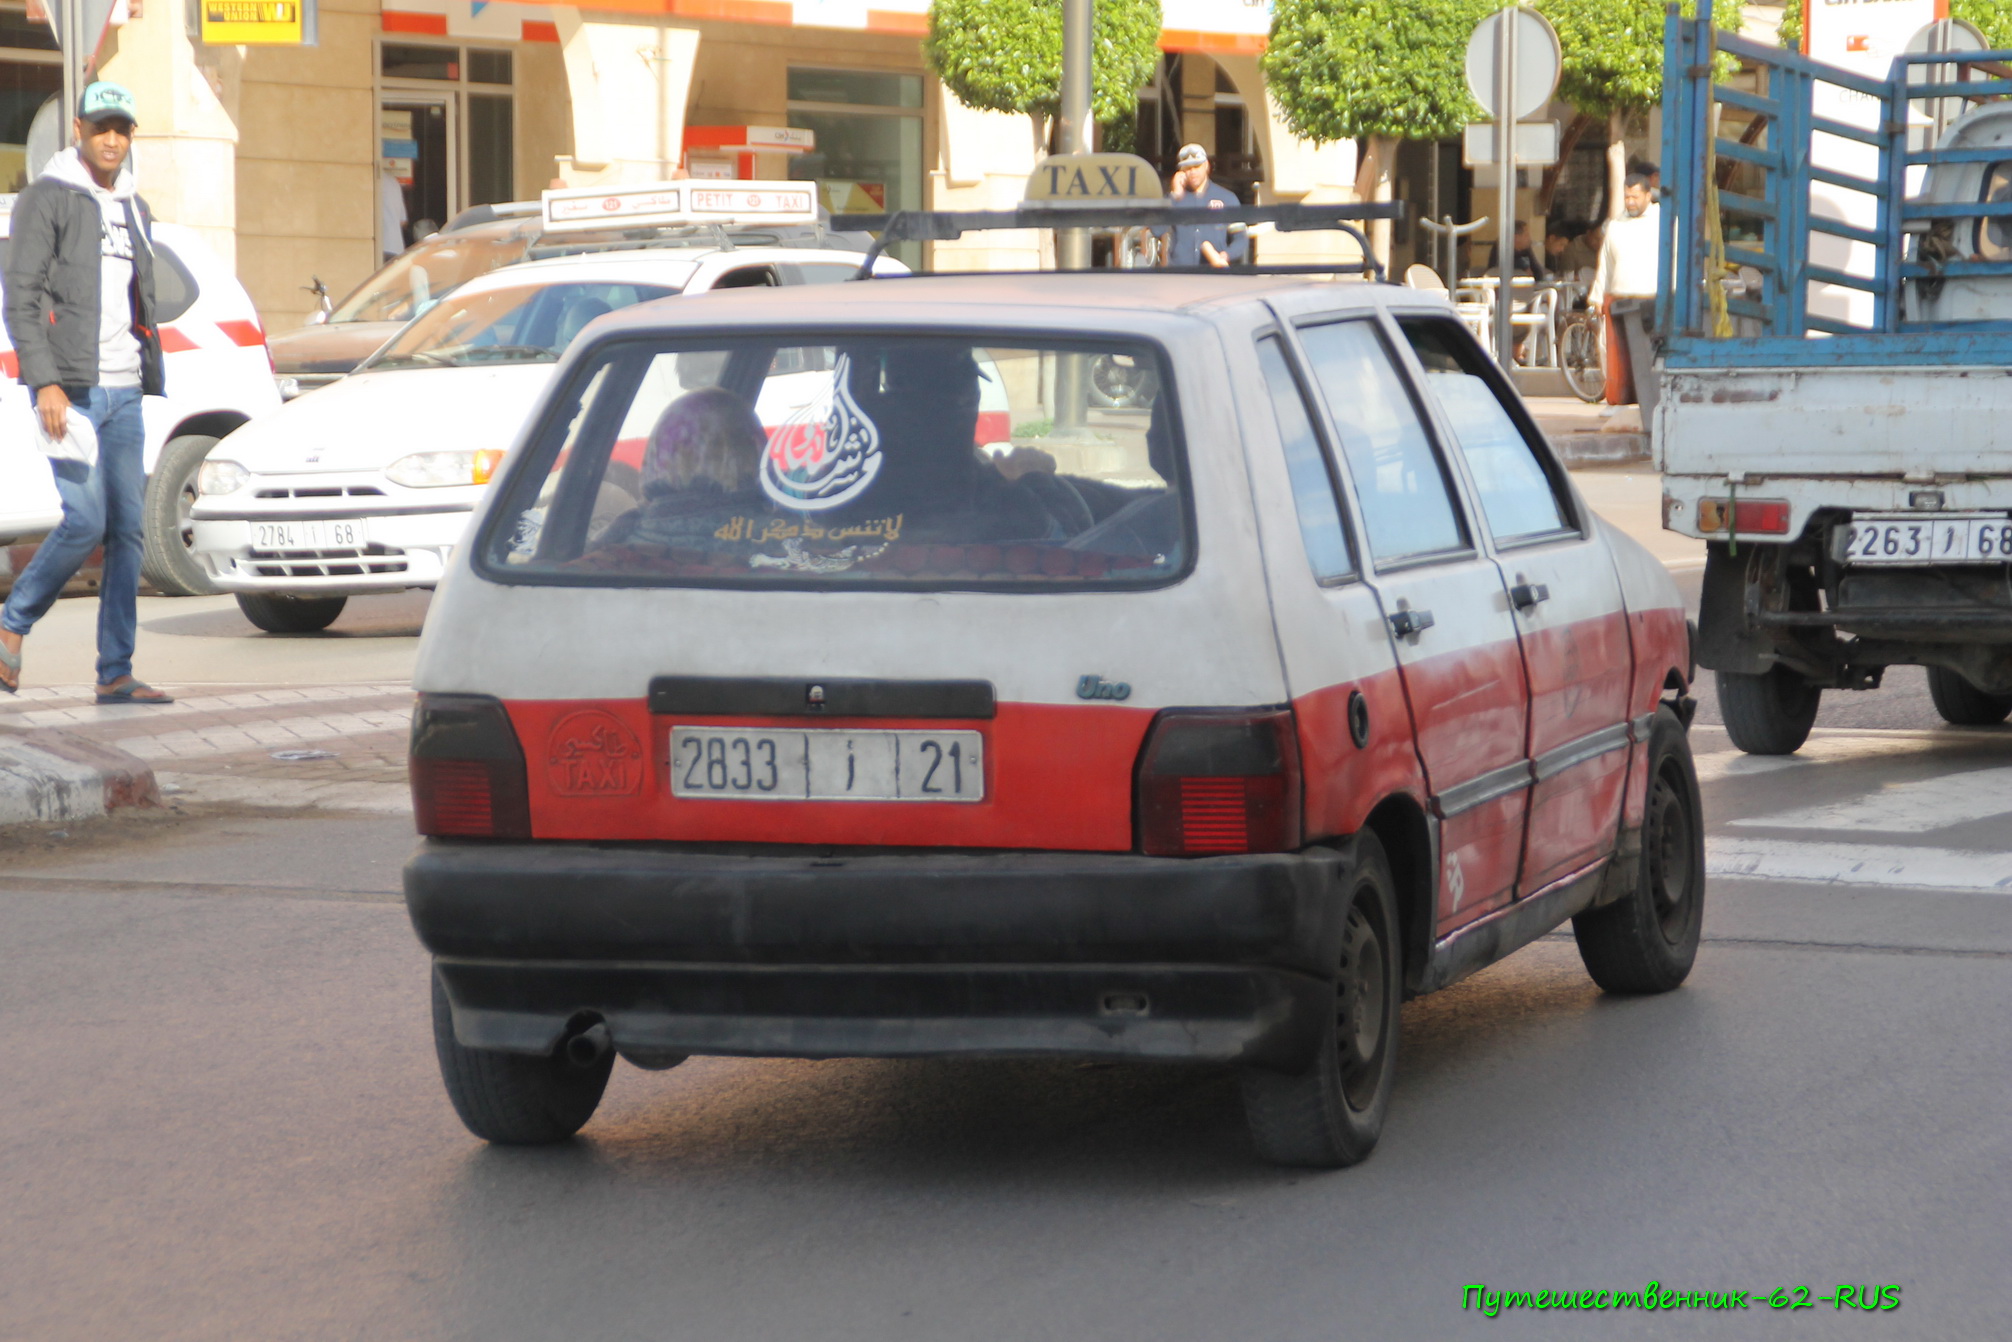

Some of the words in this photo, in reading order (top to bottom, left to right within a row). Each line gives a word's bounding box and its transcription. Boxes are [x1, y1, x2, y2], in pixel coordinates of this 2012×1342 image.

[208, 2, 258, 12] WESTERN
[223, 11, 258, 21] UNION
[1042, 164, 1138, 196] TAXI
[696, 192, 734, 208] PETIT
[775, 195, 804, 210] TAXI
[258, 525, 295, 546] 2784
[333, 523, 355, 545] 68
[1845, 525, 1922, 557] 2263
[1978, 523, 2012, 556] 68
[1076, 674, 1132, 702] Uno
[560, 759, 627, 791] TAXI
[681, 736, 779, 792] 2833
[920, 739, 963, 794] 21
